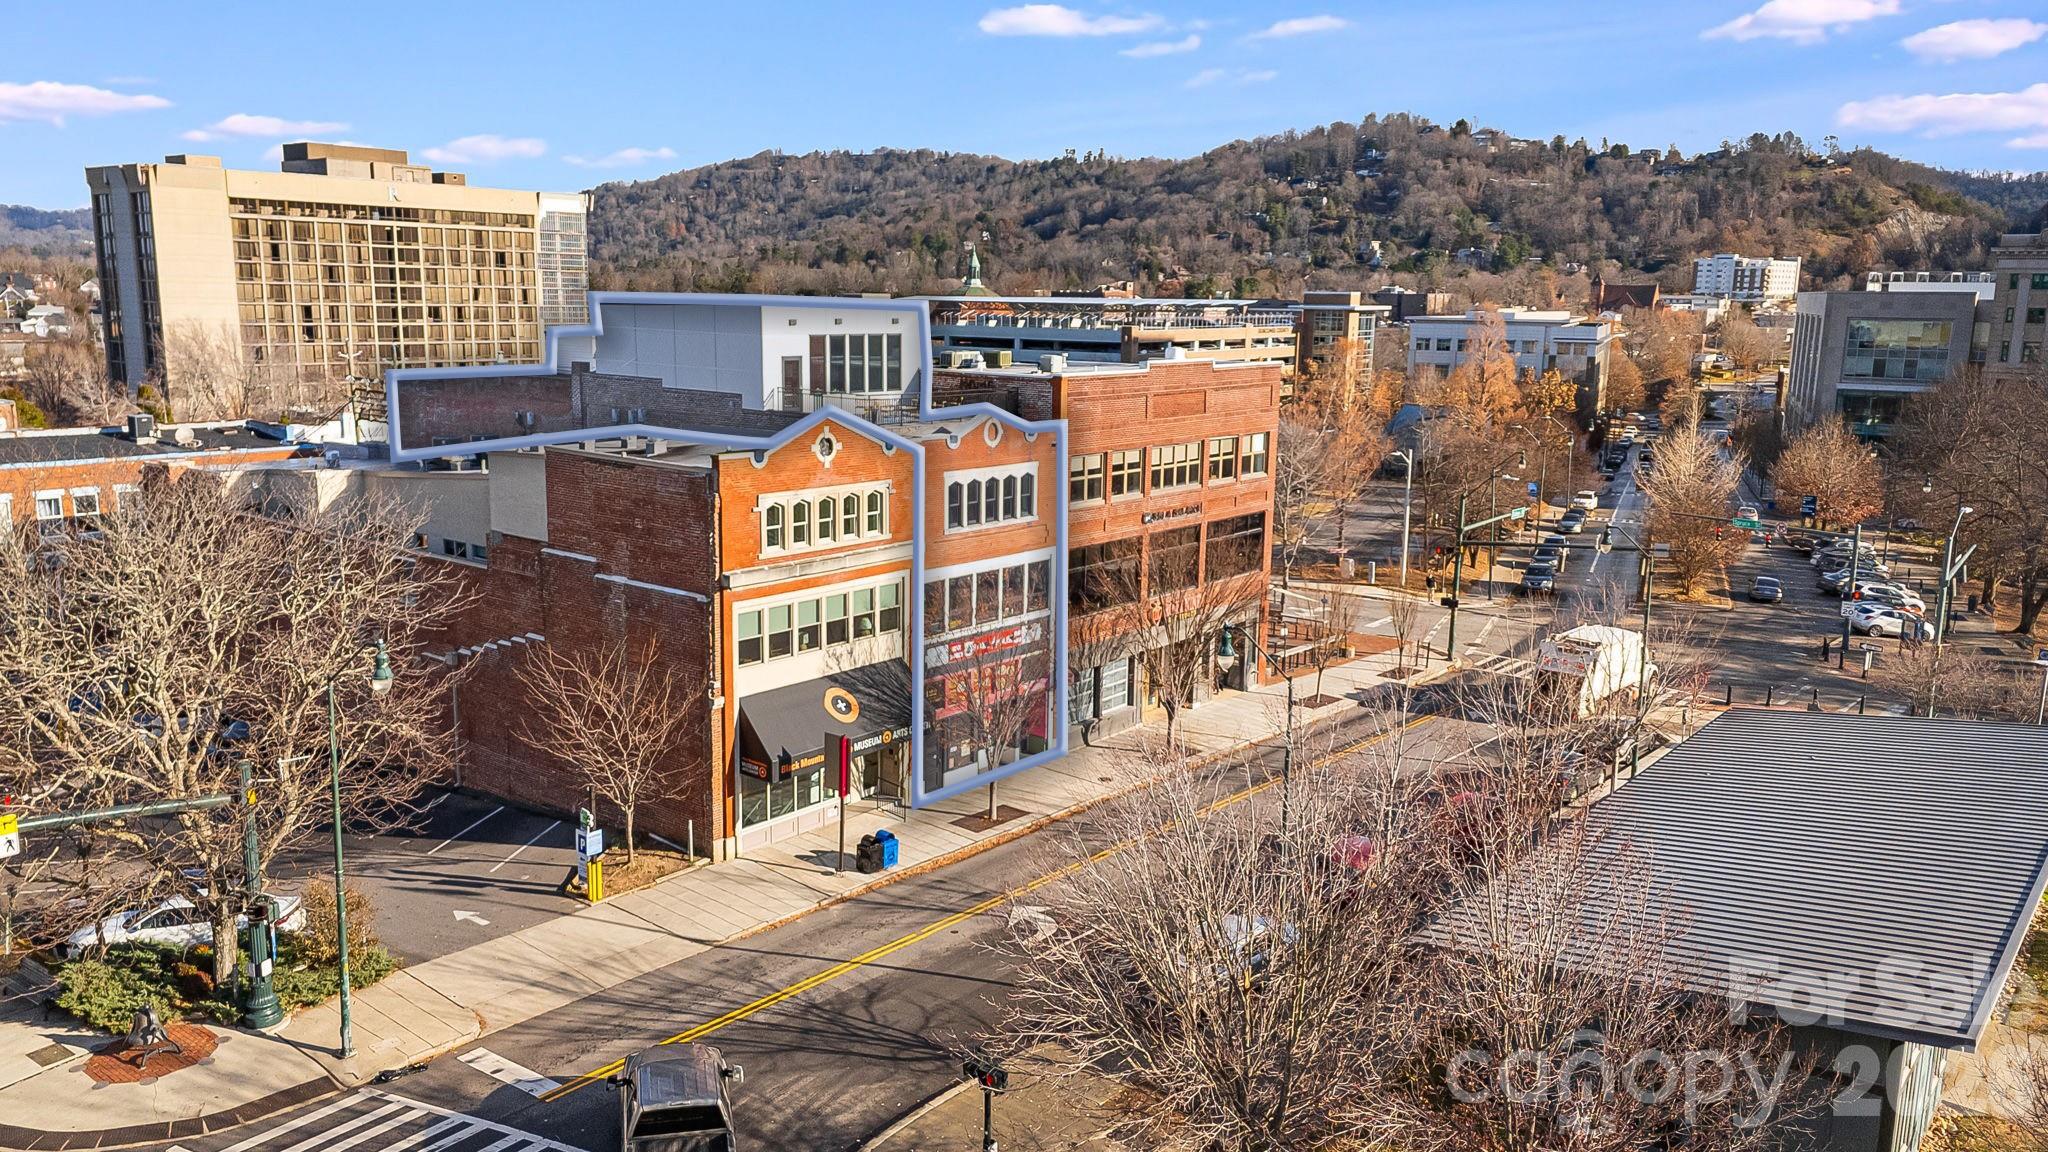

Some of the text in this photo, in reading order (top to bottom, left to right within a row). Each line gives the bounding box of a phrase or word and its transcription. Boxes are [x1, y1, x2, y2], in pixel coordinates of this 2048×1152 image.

[1842, 608, 1854, 616] 20
[854, 735, 882, 752] MUSEUM
[580, 837, 586, 850] P
